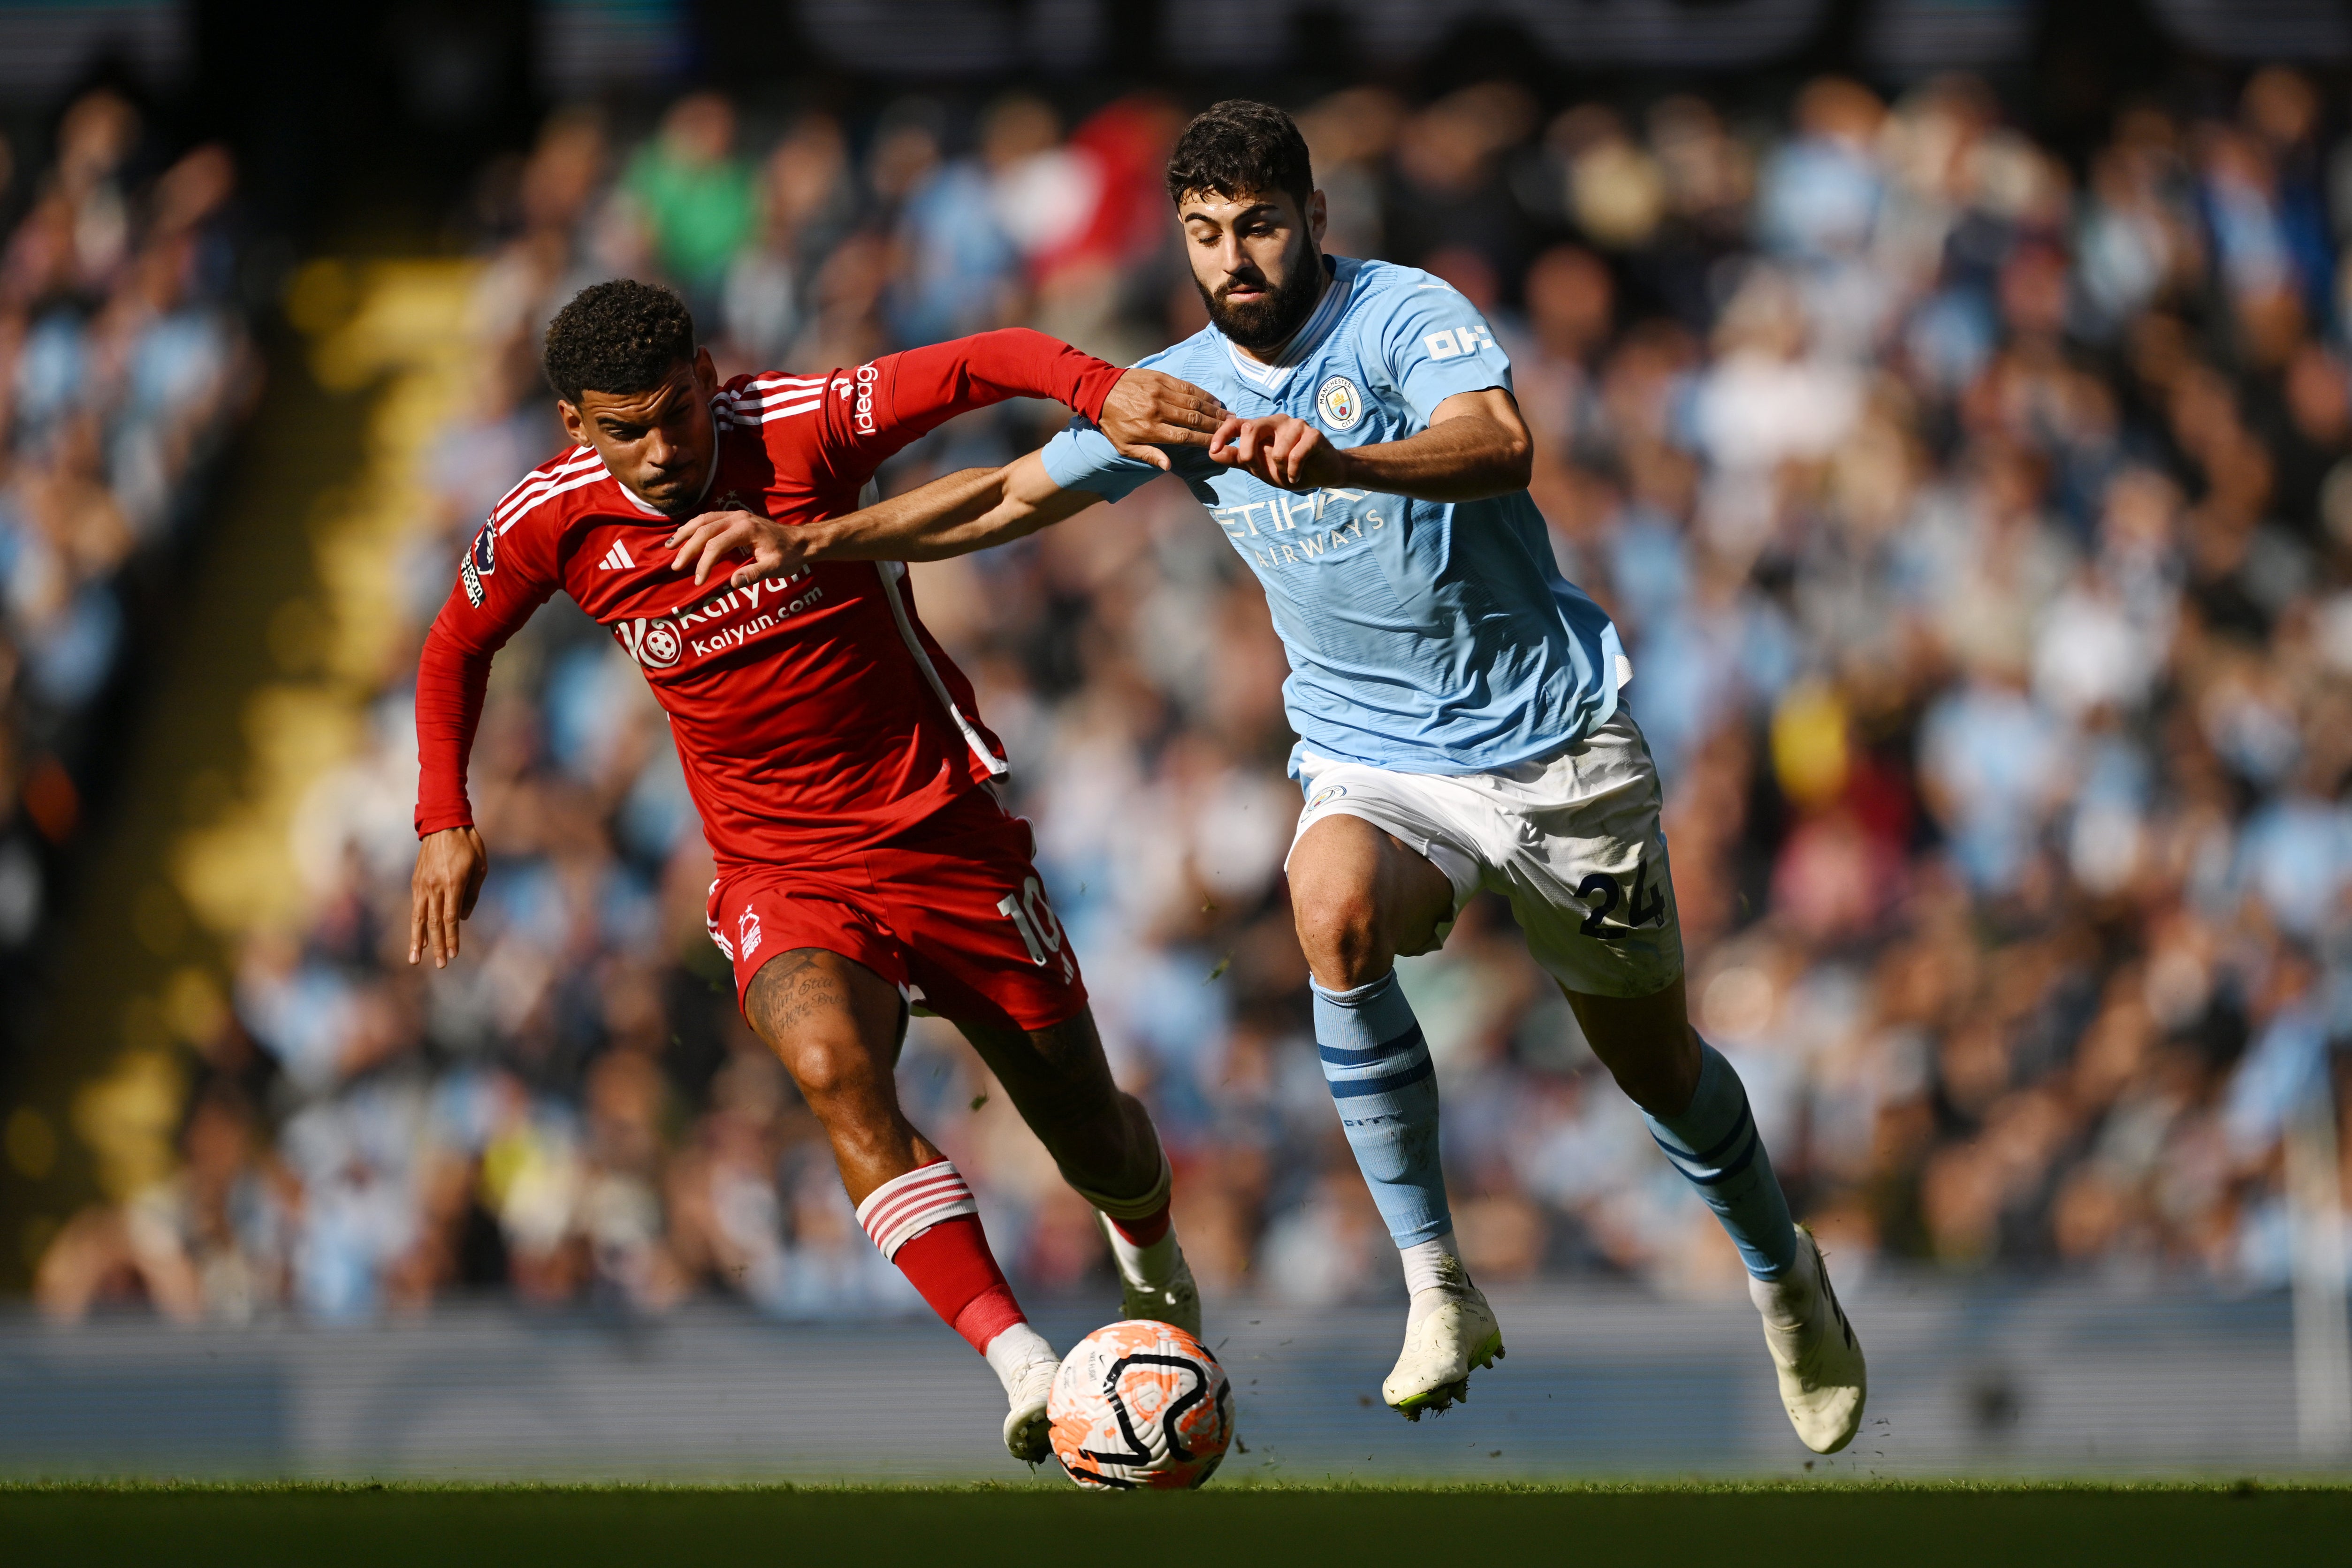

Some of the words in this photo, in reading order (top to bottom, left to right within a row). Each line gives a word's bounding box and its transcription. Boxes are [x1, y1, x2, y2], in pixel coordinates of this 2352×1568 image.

[853, 361, 878, 434] Ideag
[1319, 379, 1352, 404] MANCHESTER
[1341, 417, 1355, 427] CITY
[1214, 488, 1372, 537] ETIHA
[1255, 509, 1384, 568] AIRWAYS
[468, 563, 483, 598] room
[691, 586, 823, 657] kaiyun.com
[997, 876, 1061, 967] 10
[1574, 857, 1666, 940] 24
[743, 934, 761, 962] FOREST
